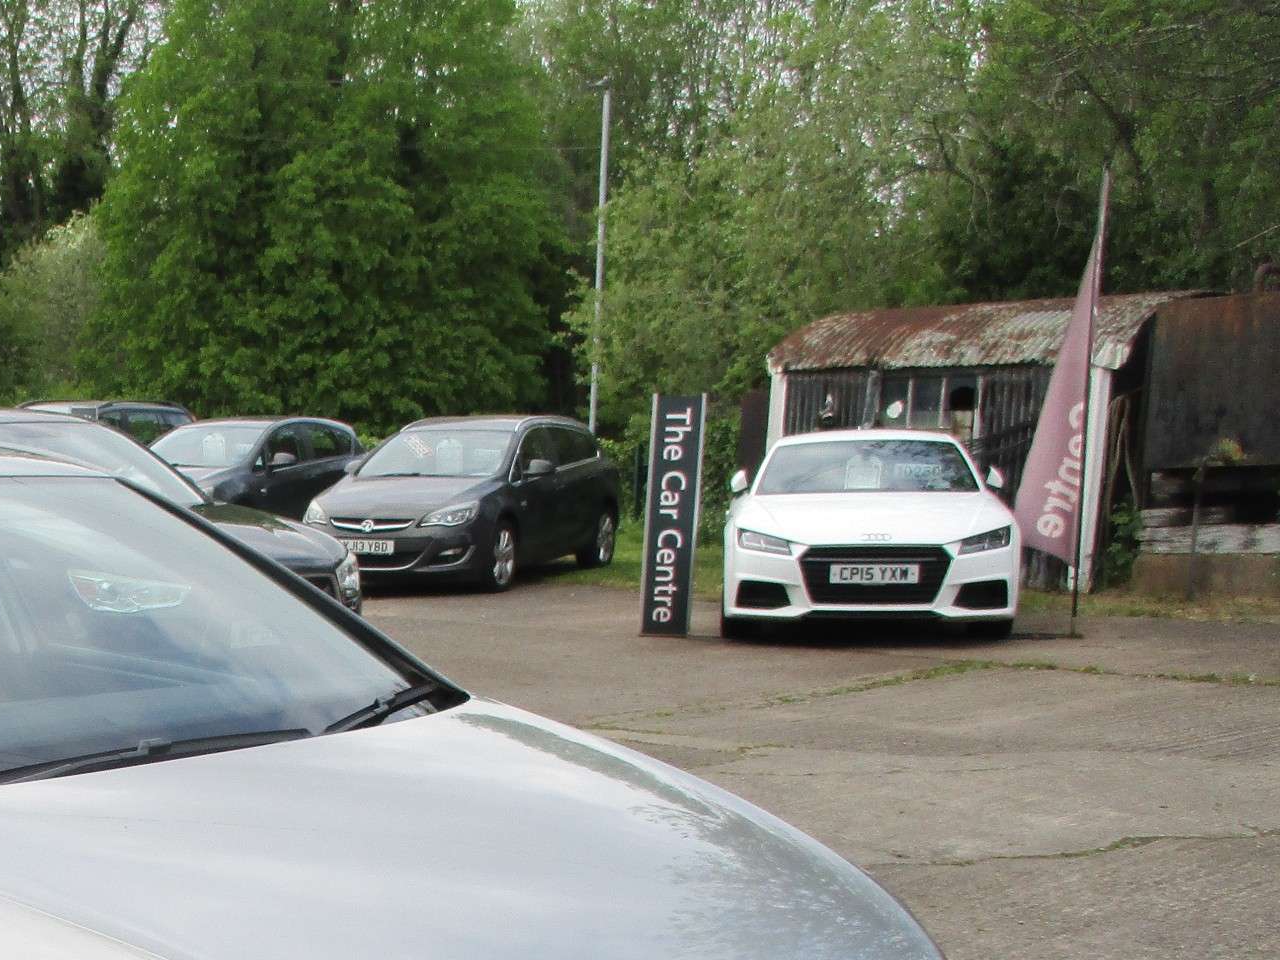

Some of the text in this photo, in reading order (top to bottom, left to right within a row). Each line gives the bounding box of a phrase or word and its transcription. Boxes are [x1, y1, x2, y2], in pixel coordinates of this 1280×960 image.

[652, 407, 692, 623] The Car Centre
[839, 567, 874, 581] CP15
